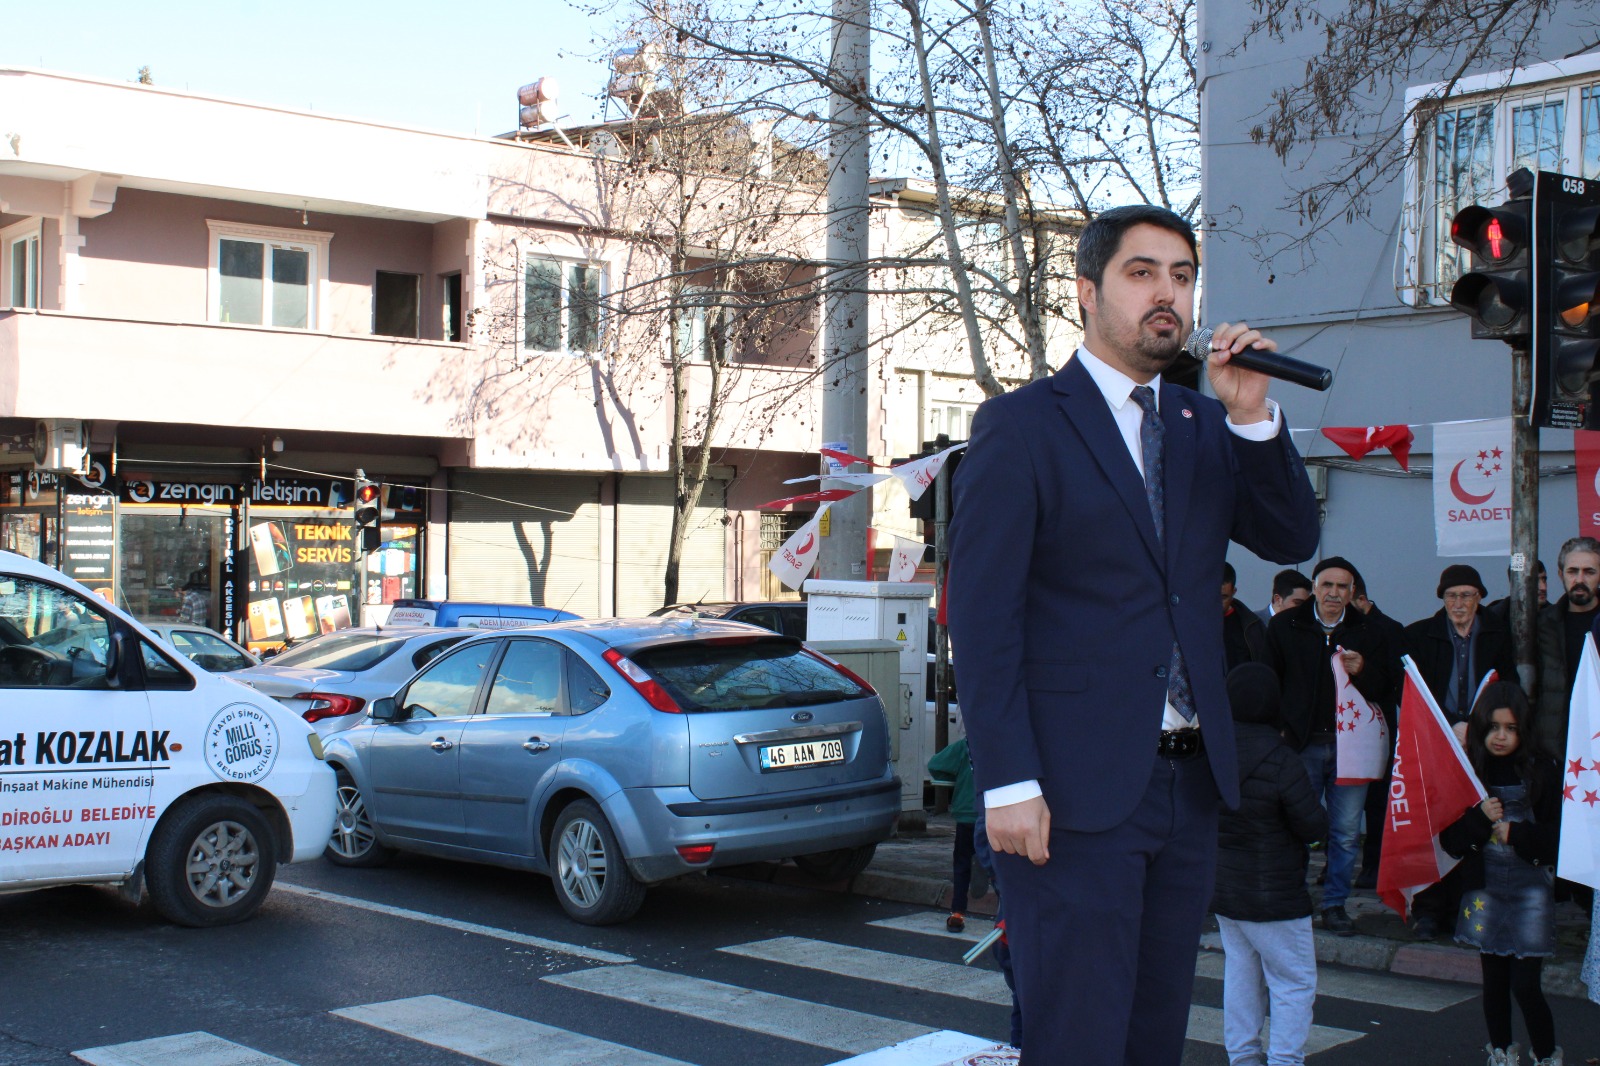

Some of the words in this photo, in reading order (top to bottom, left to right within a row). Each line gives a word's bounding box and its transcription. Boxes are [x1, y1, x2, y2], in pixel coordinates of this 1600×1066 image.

[1562, 178, 1585, 195] 058
[252, 479, 321, 505] iletişim
[1447, 508, 1512, 522] SAADET
[294, 522, 352, 541] TEKNİK
[297, 545, 352, 563] SERVİS
[213, 711, 236, 736] HAYDİ
[238, 709, 263, 722] ŞİMDİ
[35, 730, 171, 765] KOZALAK
[225, 738, 263, 764] GÖRÜŞ
[770, 748, 785, 765] 46
[794, 744, 815, 763] AAN
[820, 742, 842, 759] 209
[0, 777, 39, 793] İnşaat
[43, 779, 89, 791] Makine
[92, 776, 155, 789] Mühendisi
[0, 806, 73, 826] DİROĞLU
[81, 803, 156, 822] BELEDİYE
[63, 831, 111, 847] ADAYI
